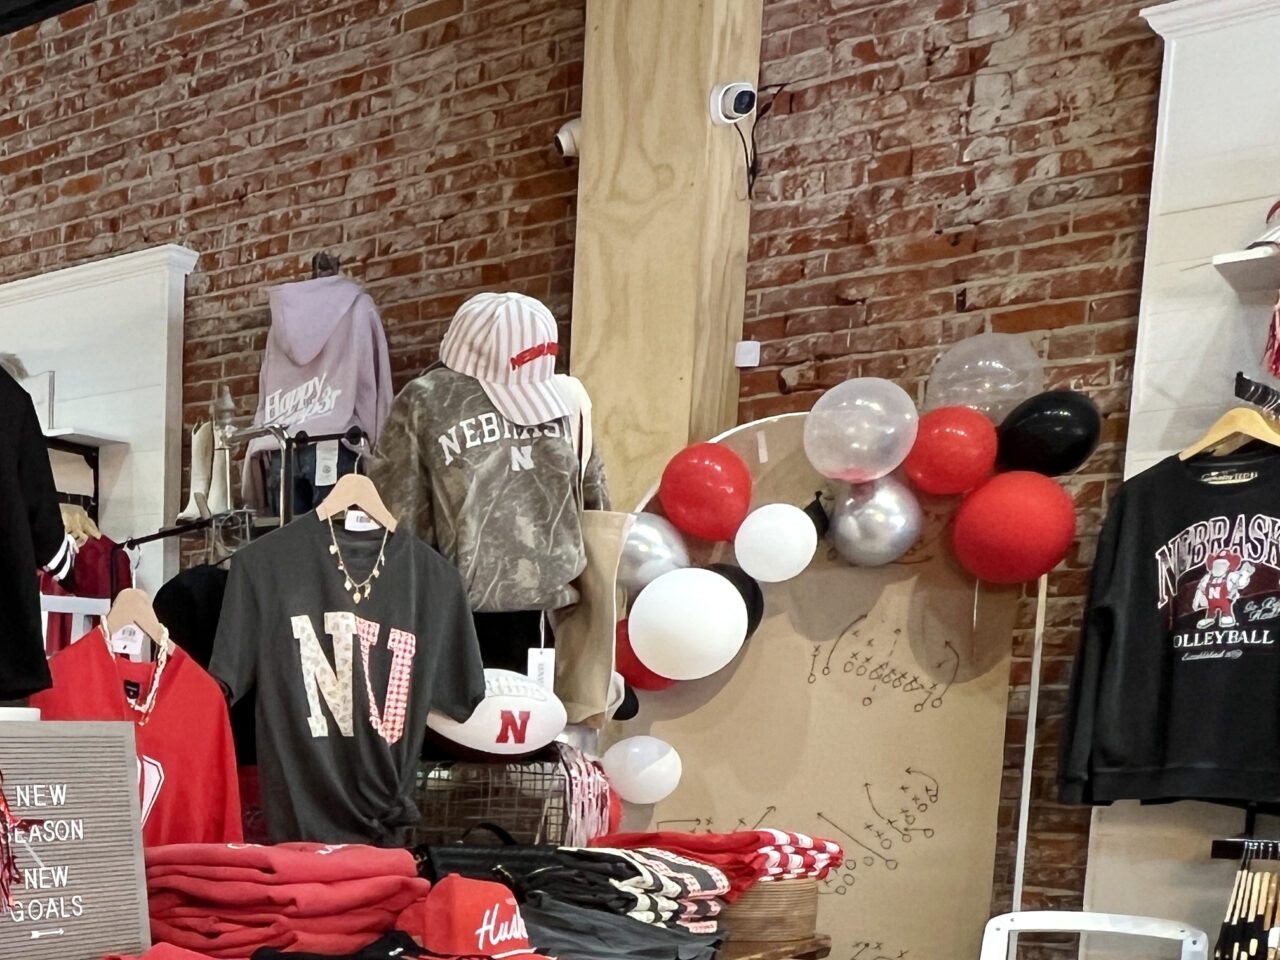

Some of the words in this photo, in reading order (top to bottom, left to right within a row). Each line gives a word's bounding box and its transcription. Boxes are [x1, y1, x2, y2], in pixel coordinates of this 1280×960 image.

[438, 412, 573, 466] NEBS
[510, 445, 535, 472] N
[290, 610, 417, 746] NU
[495, 710, 532, 744] N
[15, 784, 67, 807] NEW
[23, 865, 69, 890] NEW
[10, 895, 84, 922] GOALS
